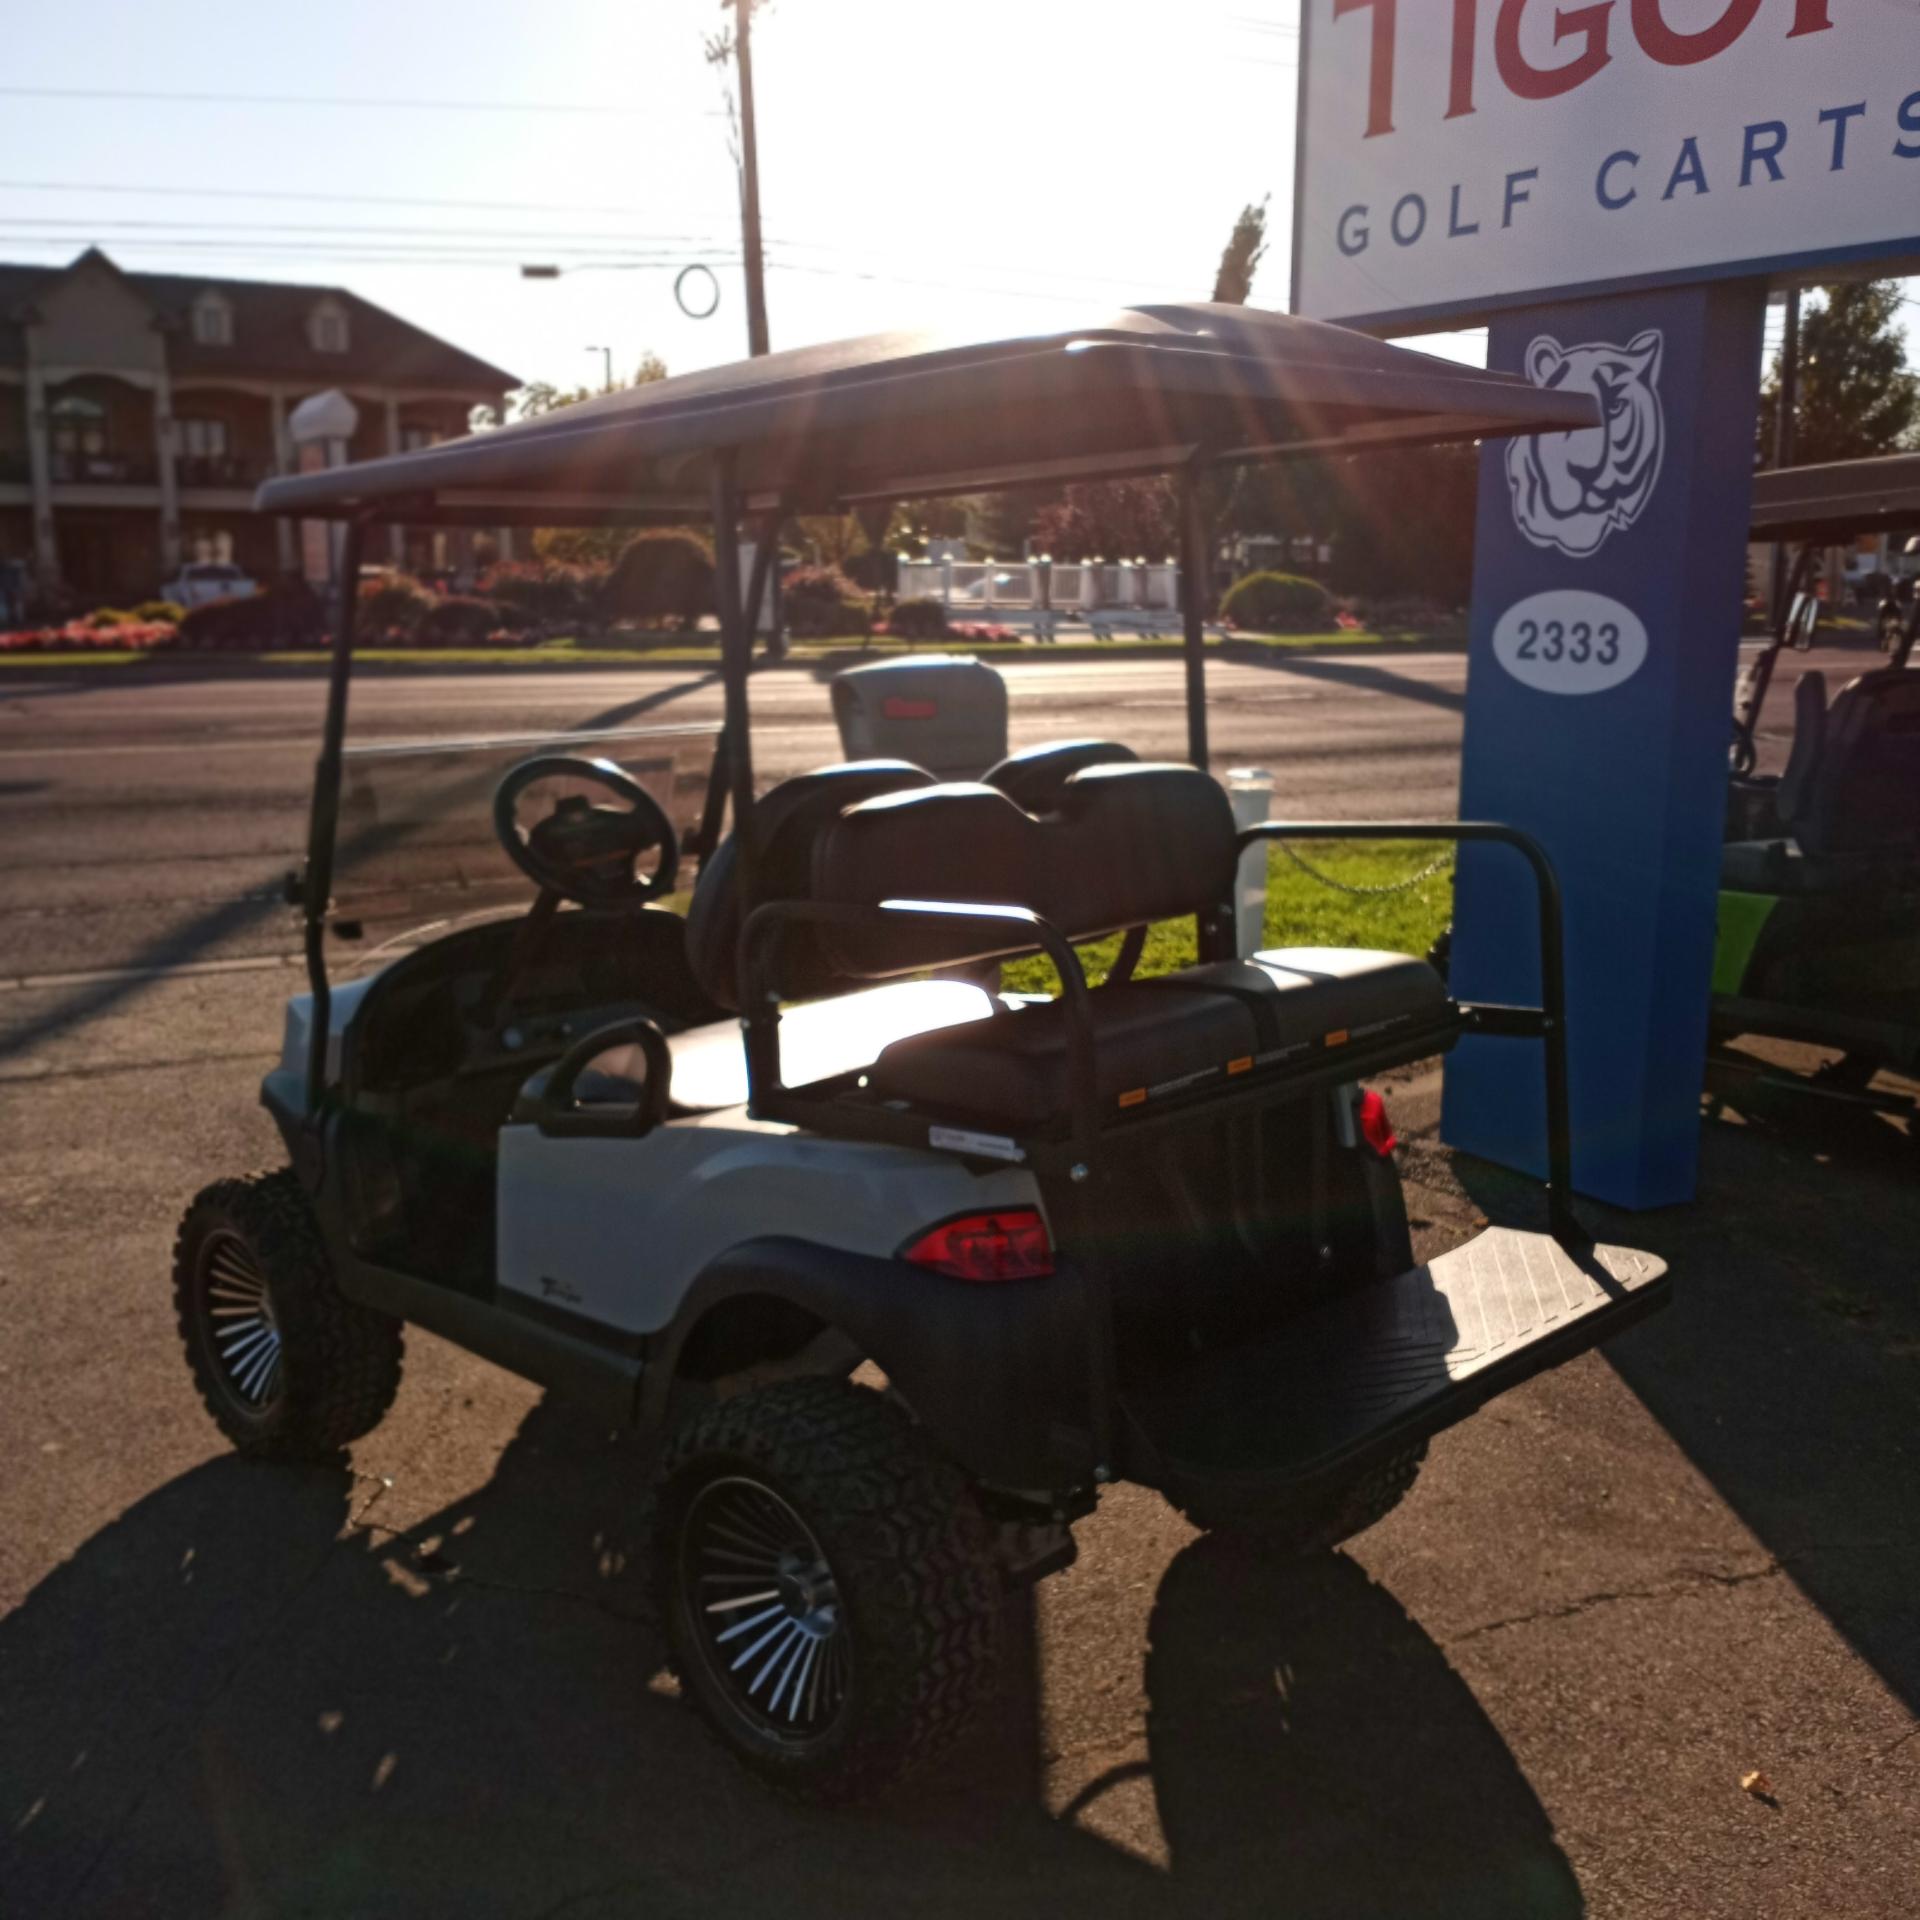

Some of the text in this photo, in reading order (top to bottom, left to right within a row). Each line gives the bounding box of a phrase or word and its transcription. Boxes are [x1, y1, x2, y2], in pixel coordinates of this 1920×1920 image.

[1332, 0, 1833, 139] TIG
[1335, 89, 1920, 258] GOLF CARTS
[1517, 619, 1620, 666] 2333
